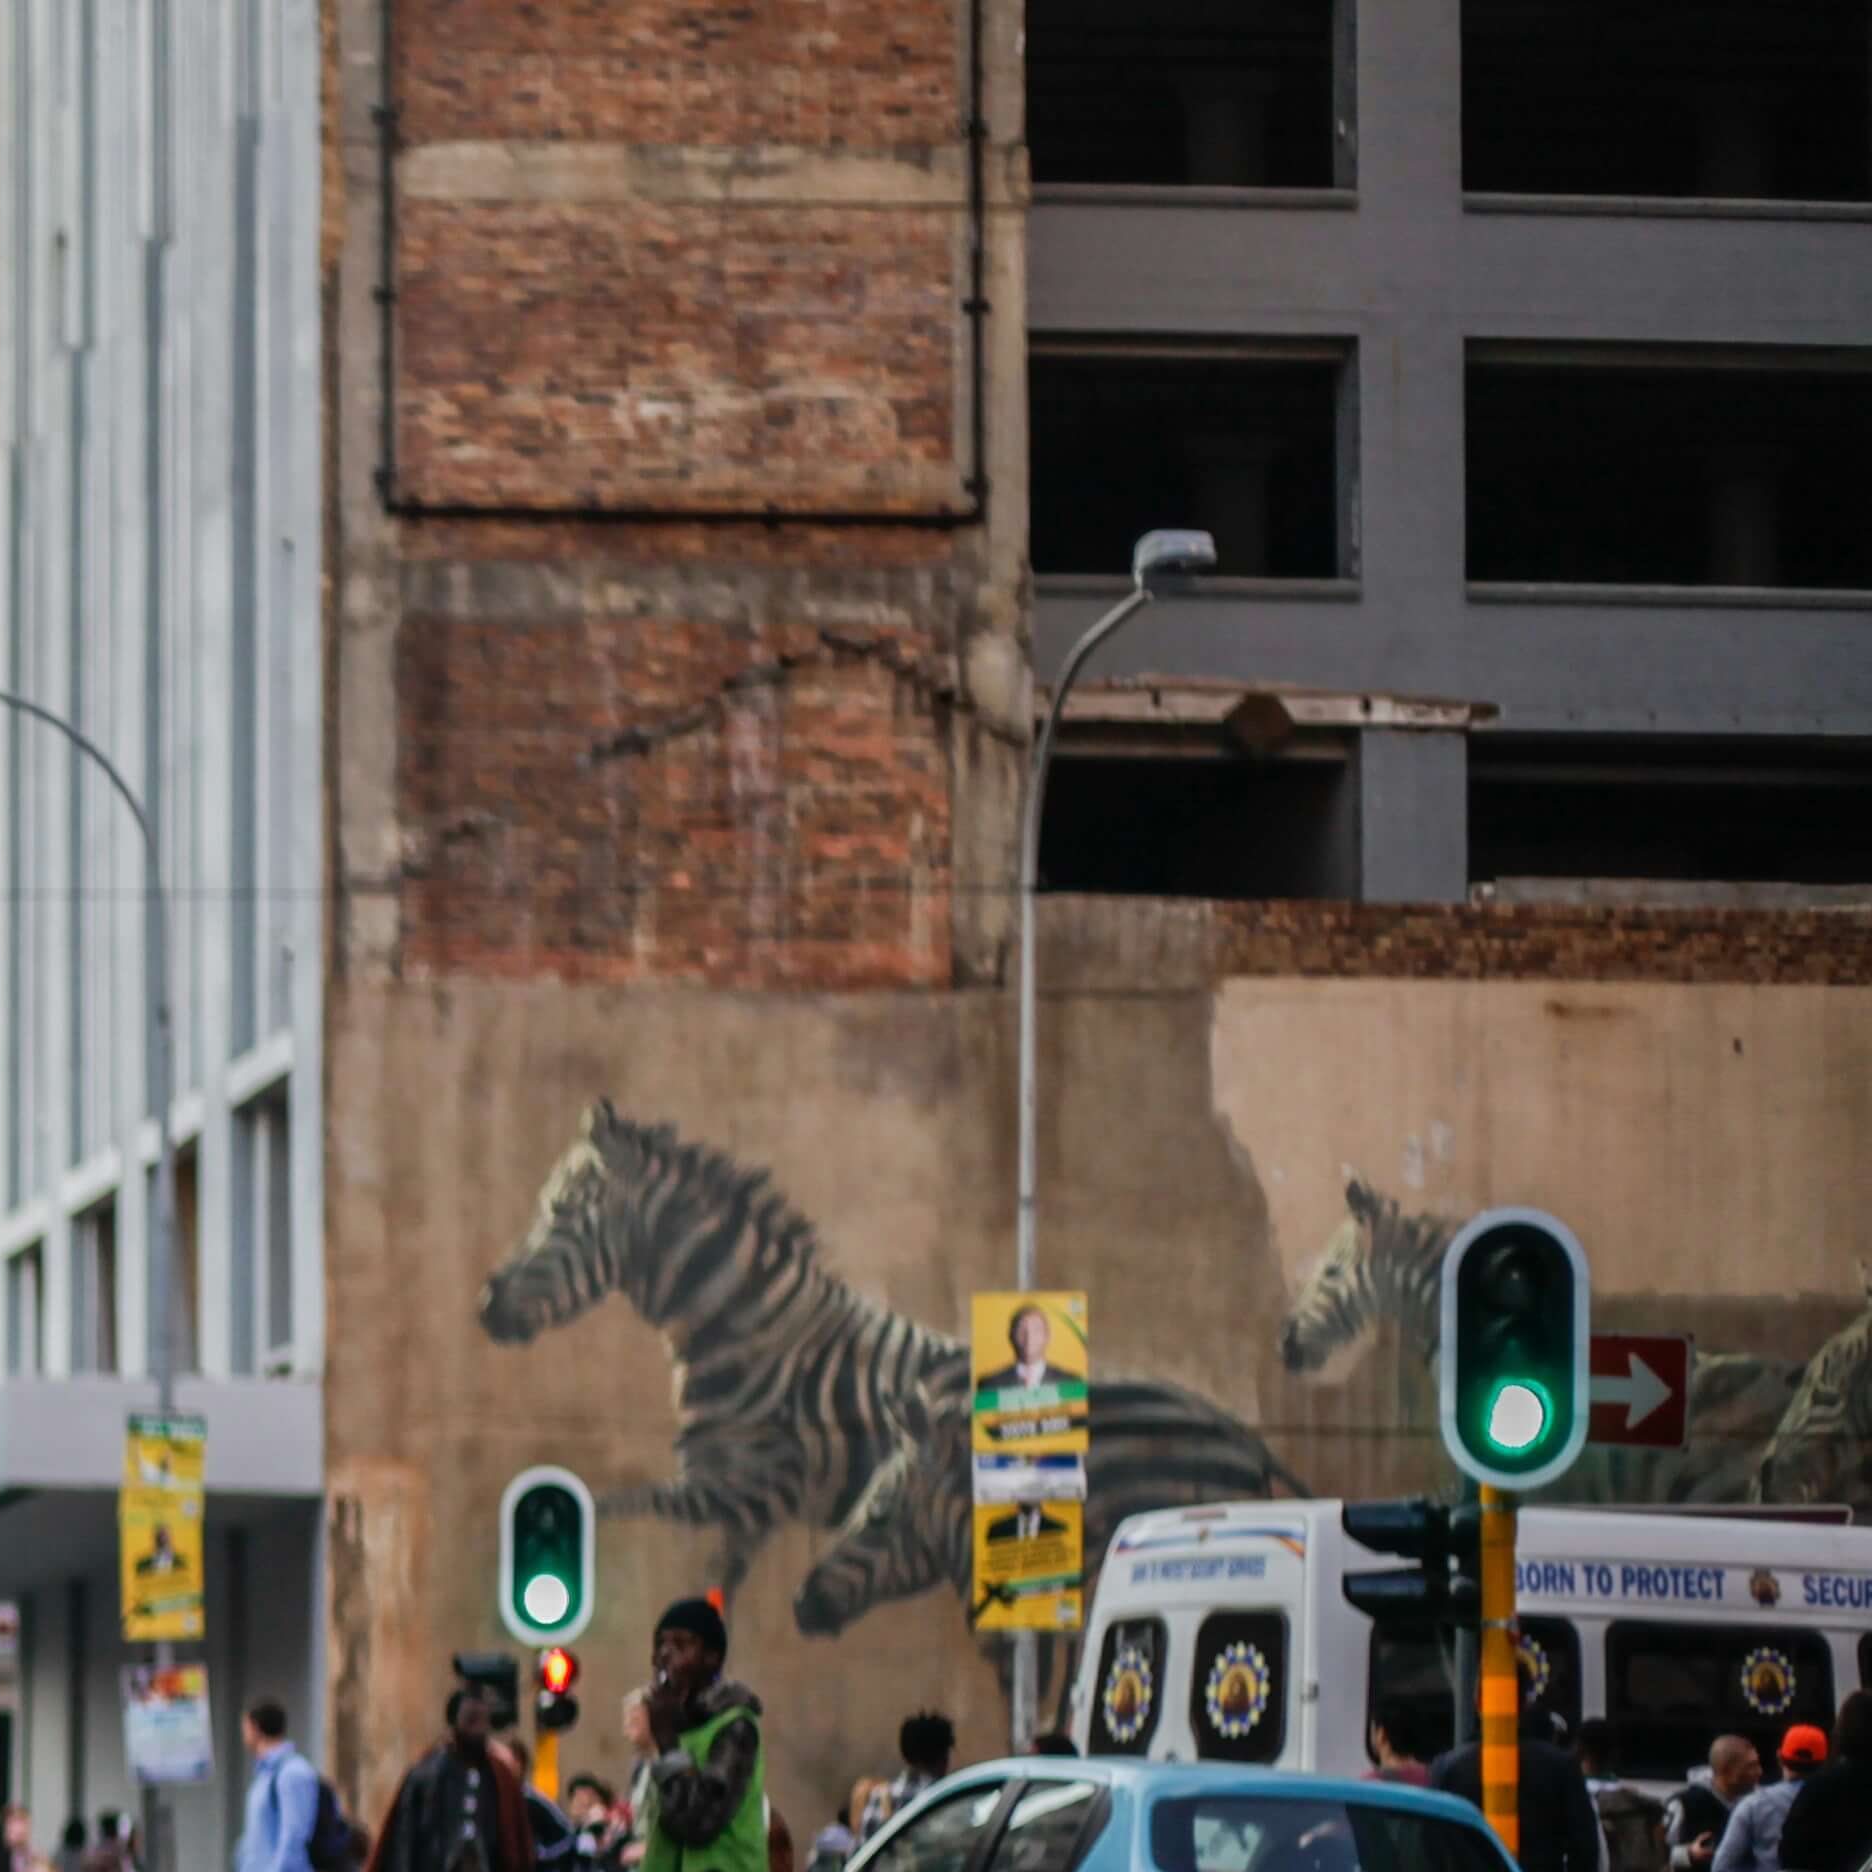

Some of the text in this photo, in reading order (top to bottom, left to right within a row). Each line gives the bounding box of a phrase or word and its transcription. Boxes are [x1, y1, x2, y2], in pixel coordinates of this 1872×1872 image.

[1516, 1562, 1726, 1601] BORN TO PROTECT
